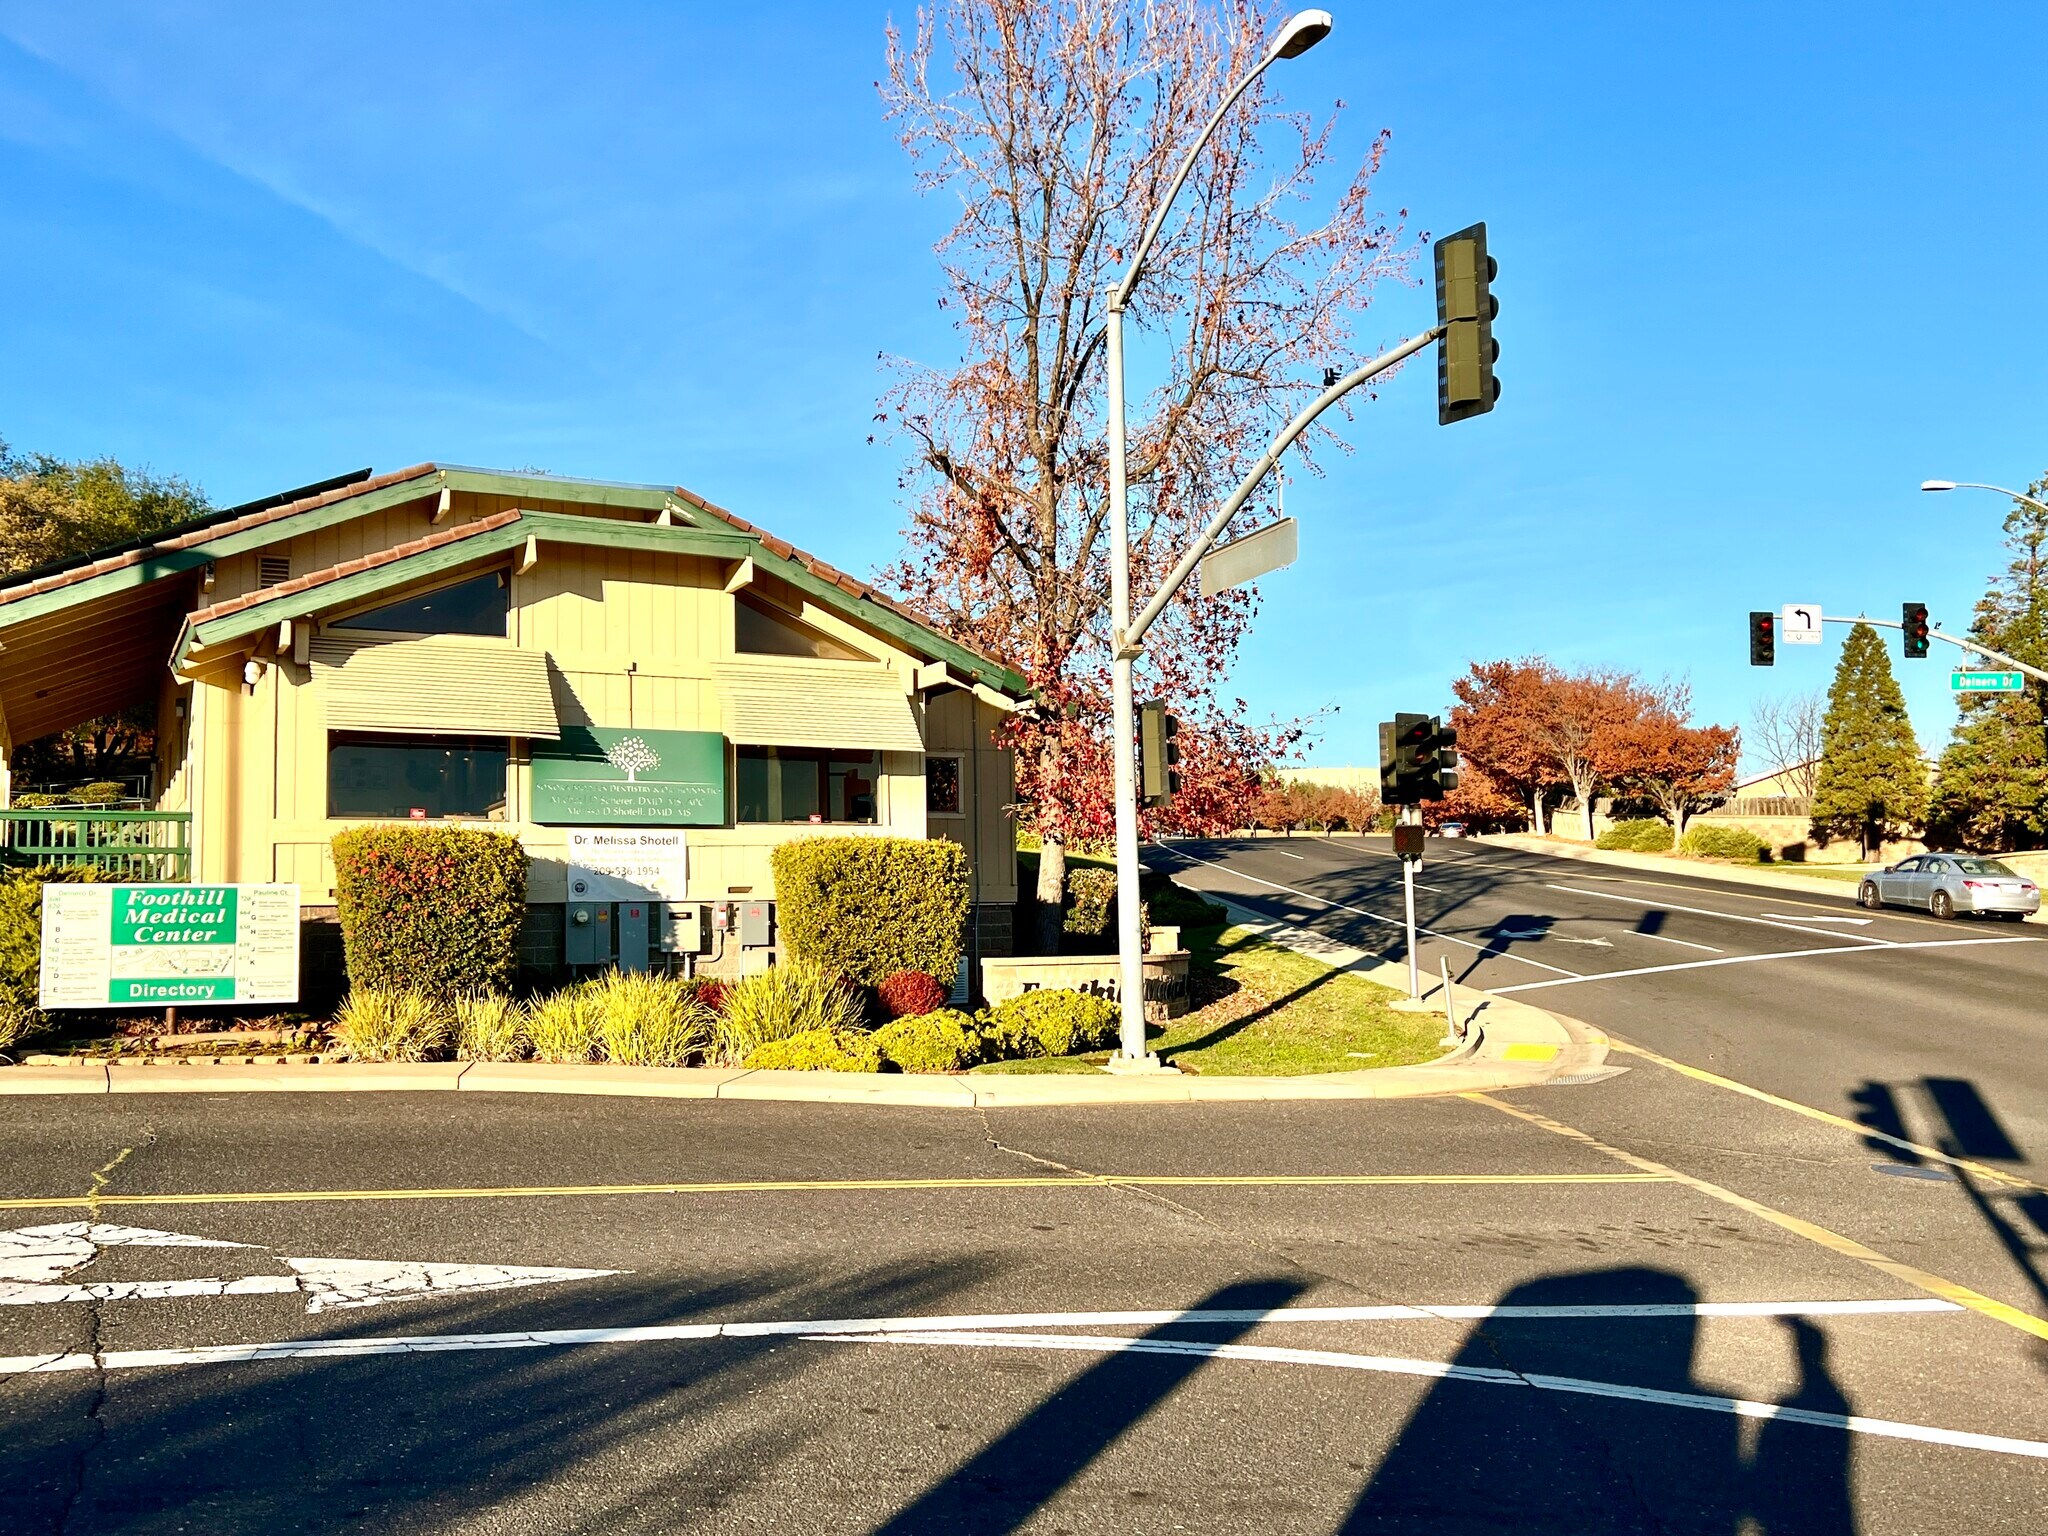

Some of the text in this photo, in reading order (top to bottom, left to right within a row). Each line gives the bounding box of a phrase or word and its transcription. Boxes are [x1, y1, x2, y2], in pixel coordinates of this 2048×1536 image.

[2002, 676, 2013, 687] Dr
[610, 784, 651, 793] DENTISTRY
[593, 835, 637, 845] Melissa
[640, 835, 679, 846] Shotell
[126, 889, 226, 906] Foothill
[123, 908, 226, 924] Medical
[133, 926, 217, 943] Center
[129, 983, 216, 999] Directory
